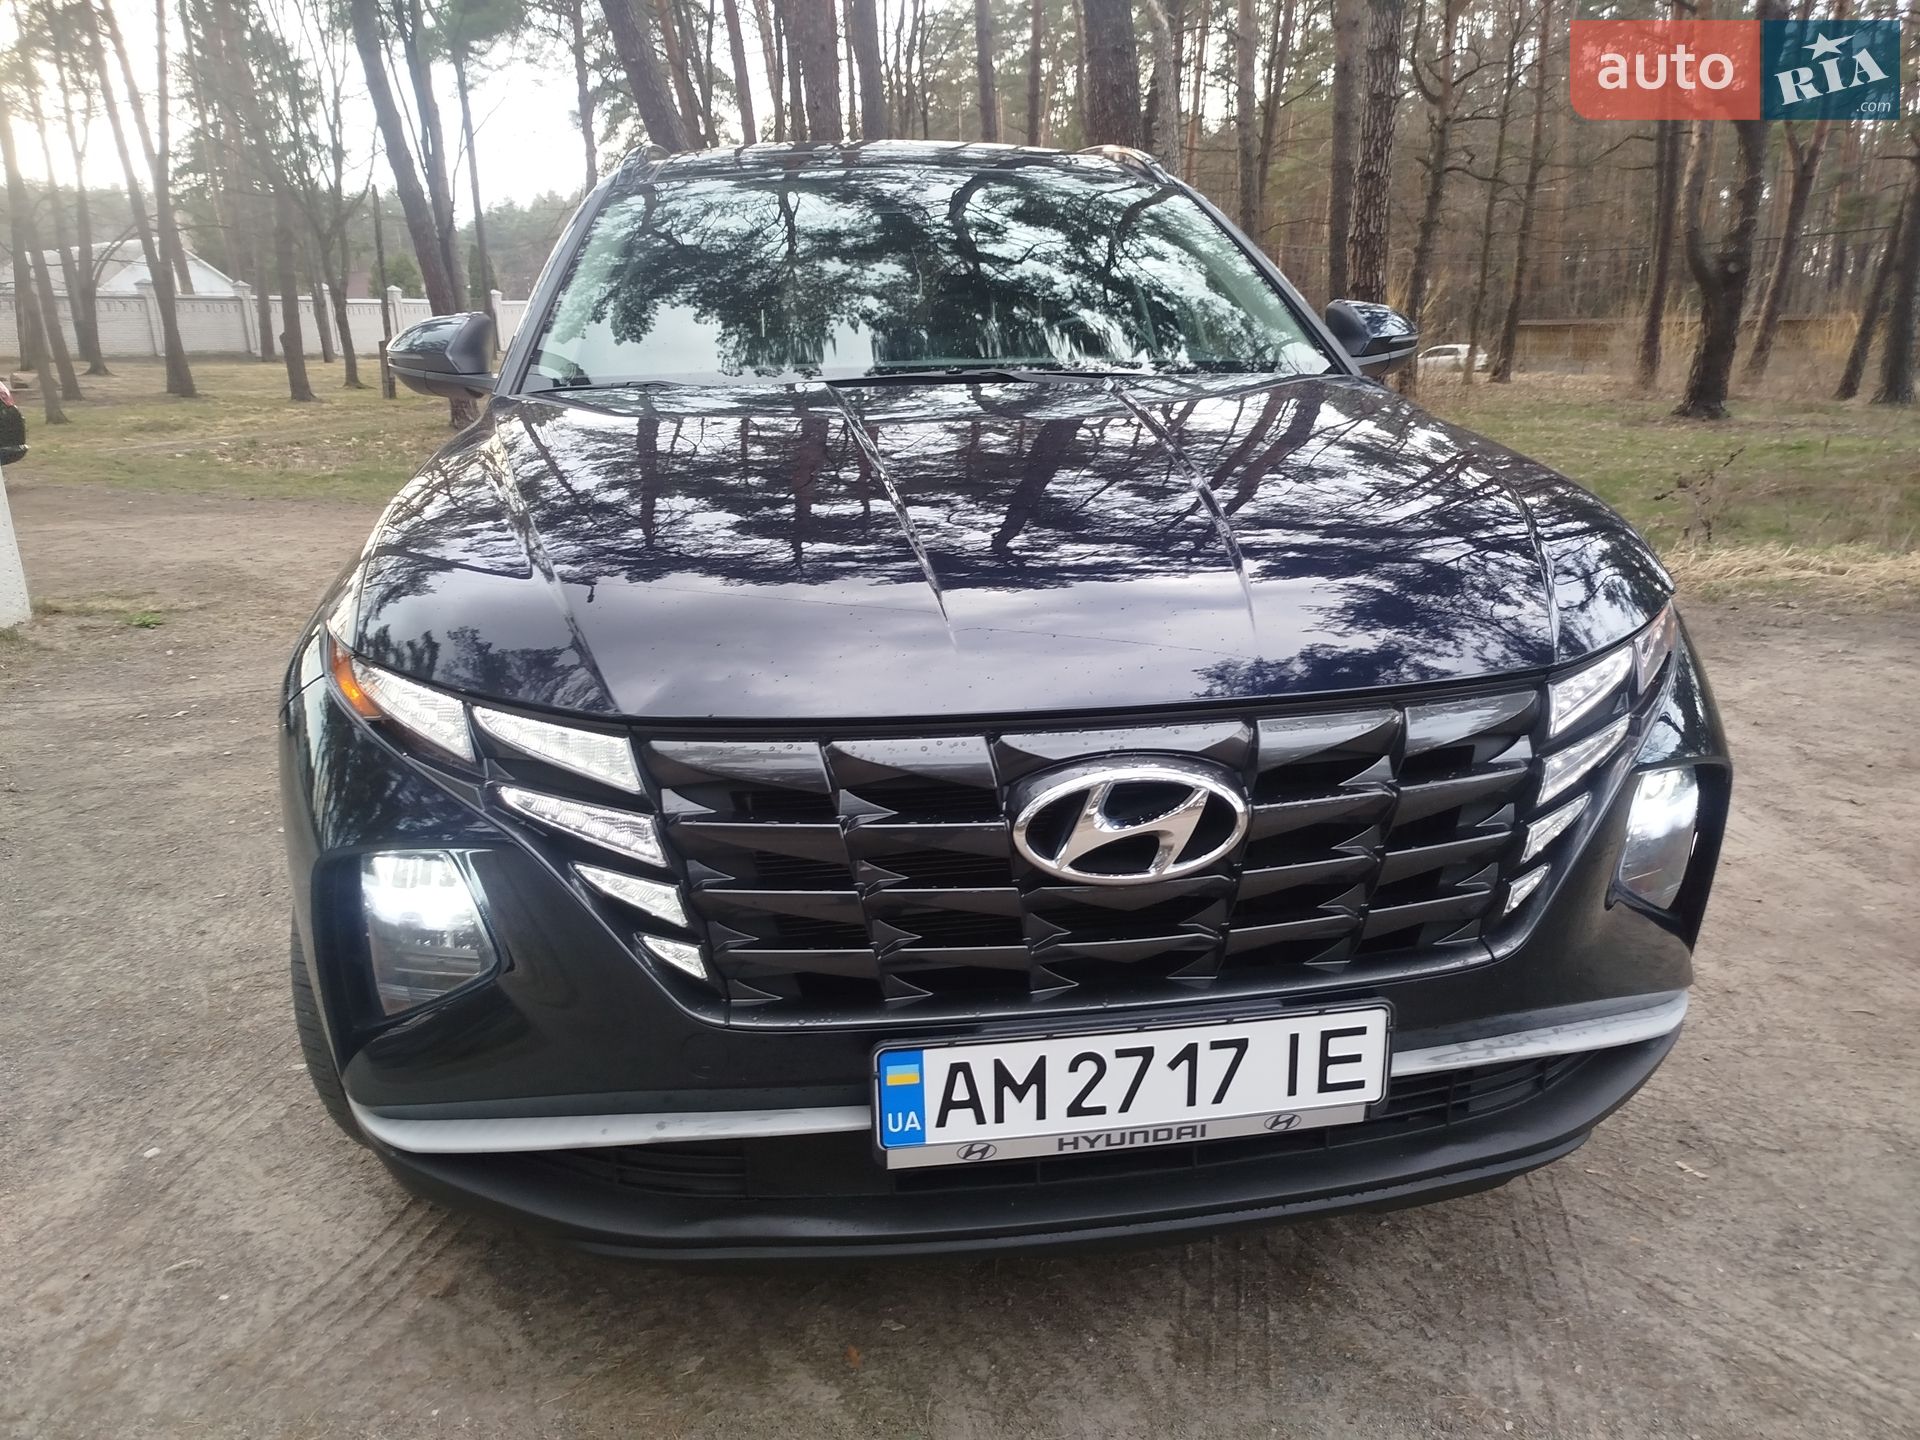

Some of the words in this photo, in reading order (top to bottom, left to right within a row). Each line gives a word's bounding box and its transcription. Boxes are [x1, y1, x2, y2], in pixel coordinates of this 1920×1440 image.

[935, 1055, 1047, 1128] AM
[1066, 1037, 1250, 1118] 2717
[1286, 1026, 1368, 1097] IE
[887, 1113, 922, 1134] UA
[1057, 1123, 1207, 1152] HYUNDAI
